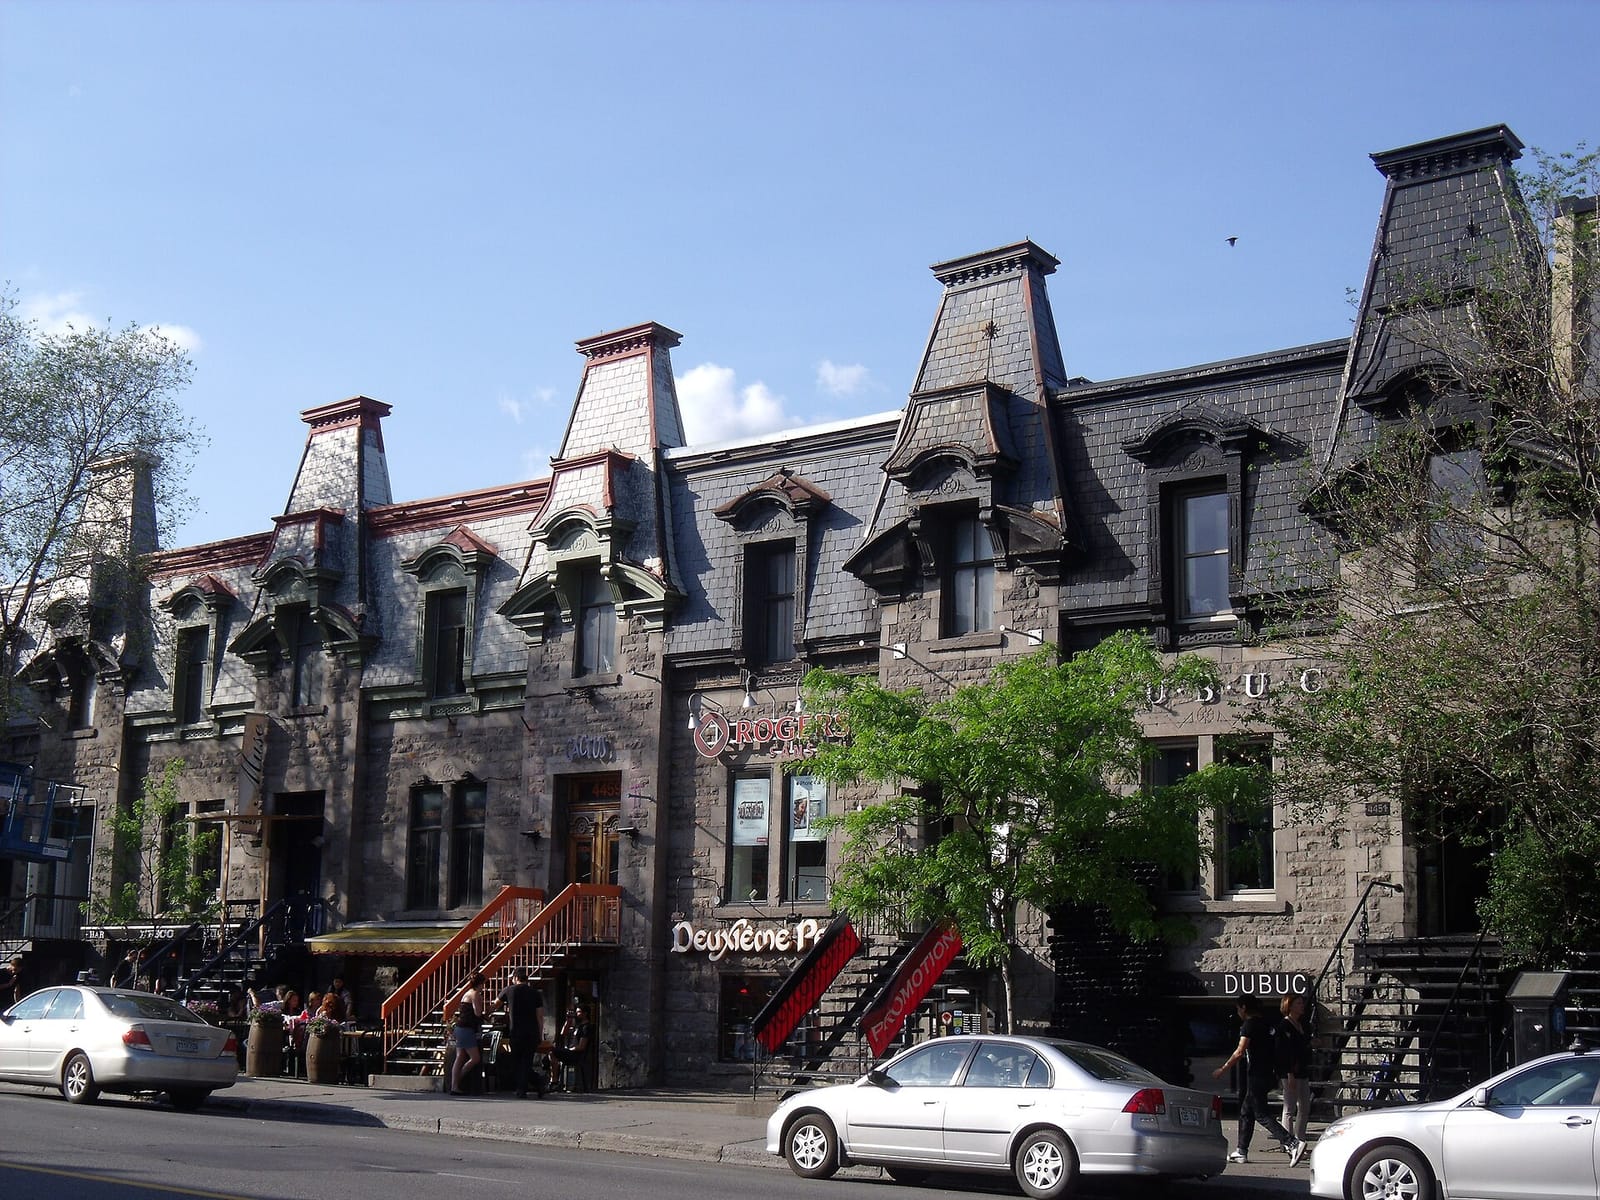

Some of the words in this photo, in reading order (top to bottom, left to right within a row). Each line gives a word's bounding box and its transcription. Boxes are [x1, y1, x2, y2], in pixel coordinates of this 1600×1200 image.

[736, 713, 850, 744] ROGERS
[869, 930, 957, 1043] PROMOTION
[1224, 973, 1307, 995] DUBUC
